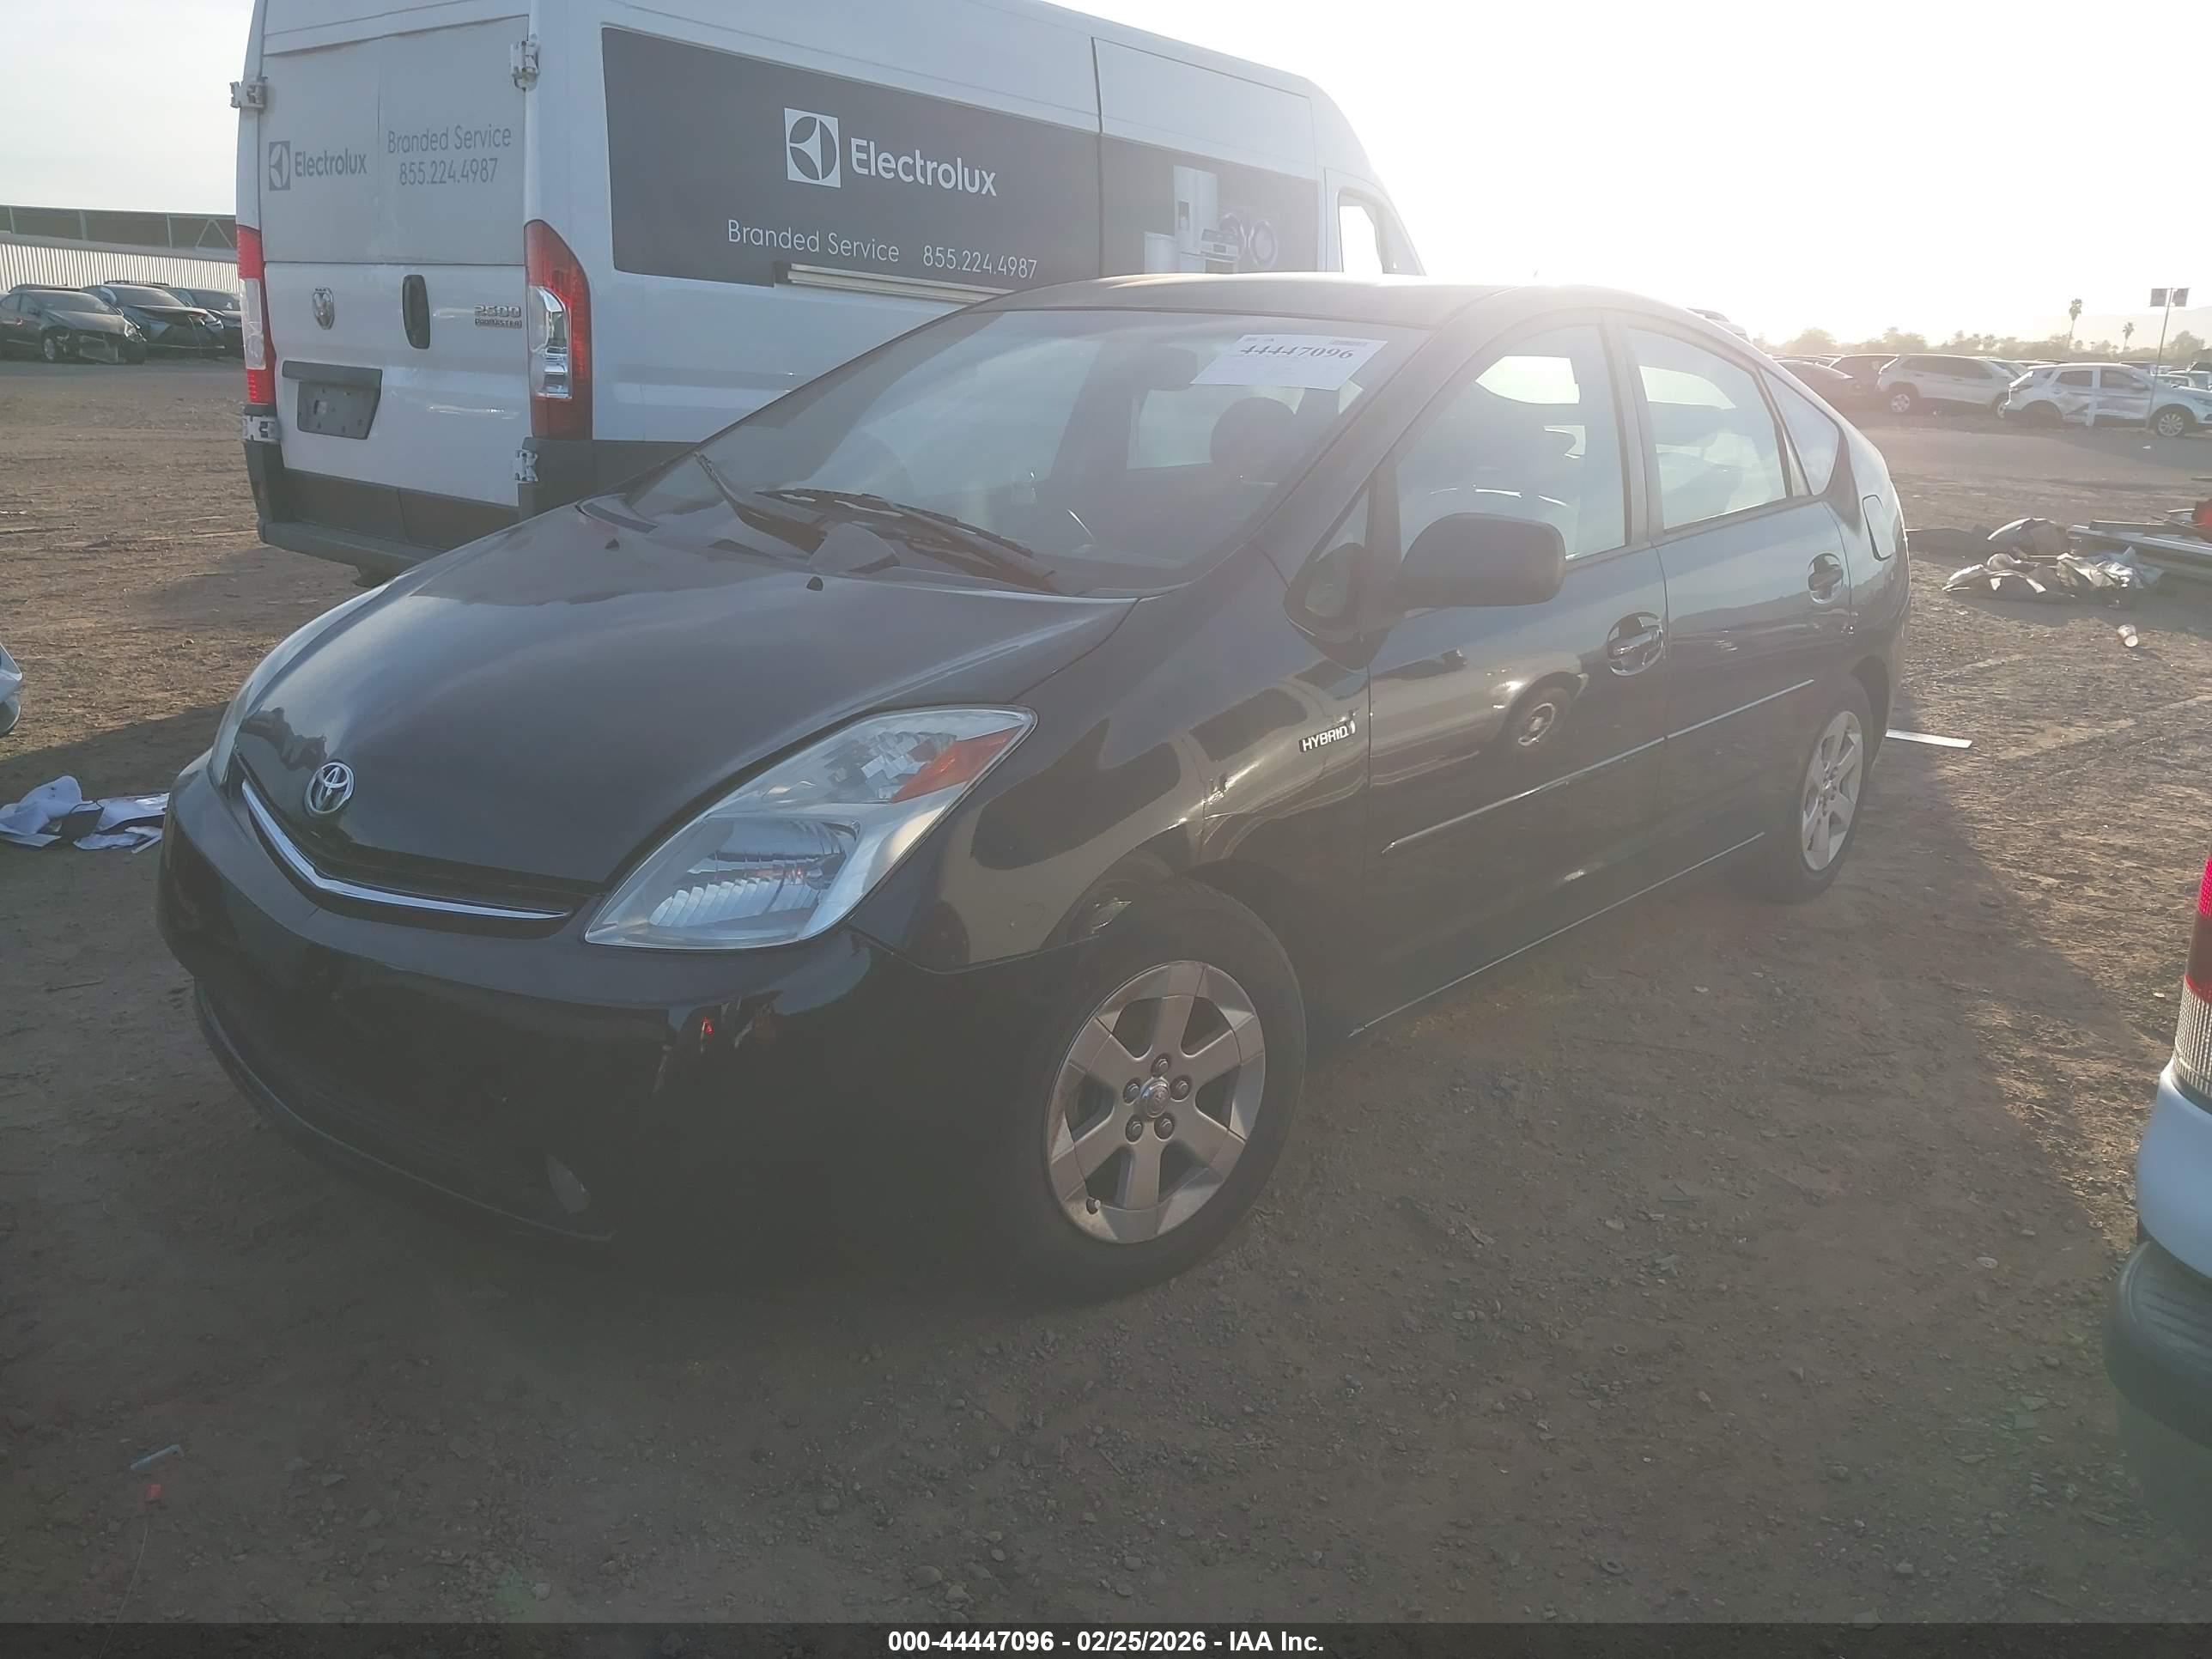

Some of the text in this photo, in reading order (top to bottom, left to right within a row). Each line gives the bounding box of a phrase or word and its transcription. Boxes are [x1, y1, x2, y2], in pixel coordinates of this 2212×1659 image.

[387, 124, 512, 154] Branded Service
[295, 149, 367, 177] Electrolux
[399, 158, 498, 185] 855.224.4987
[851, 137, 997, 197] Electrolux
[727, 219, 1037, 280] Branded Service 855.224.4987
[1241, 344, 1354, 358] 44447096
[1301, 725, 1349, 751] HYBRID
